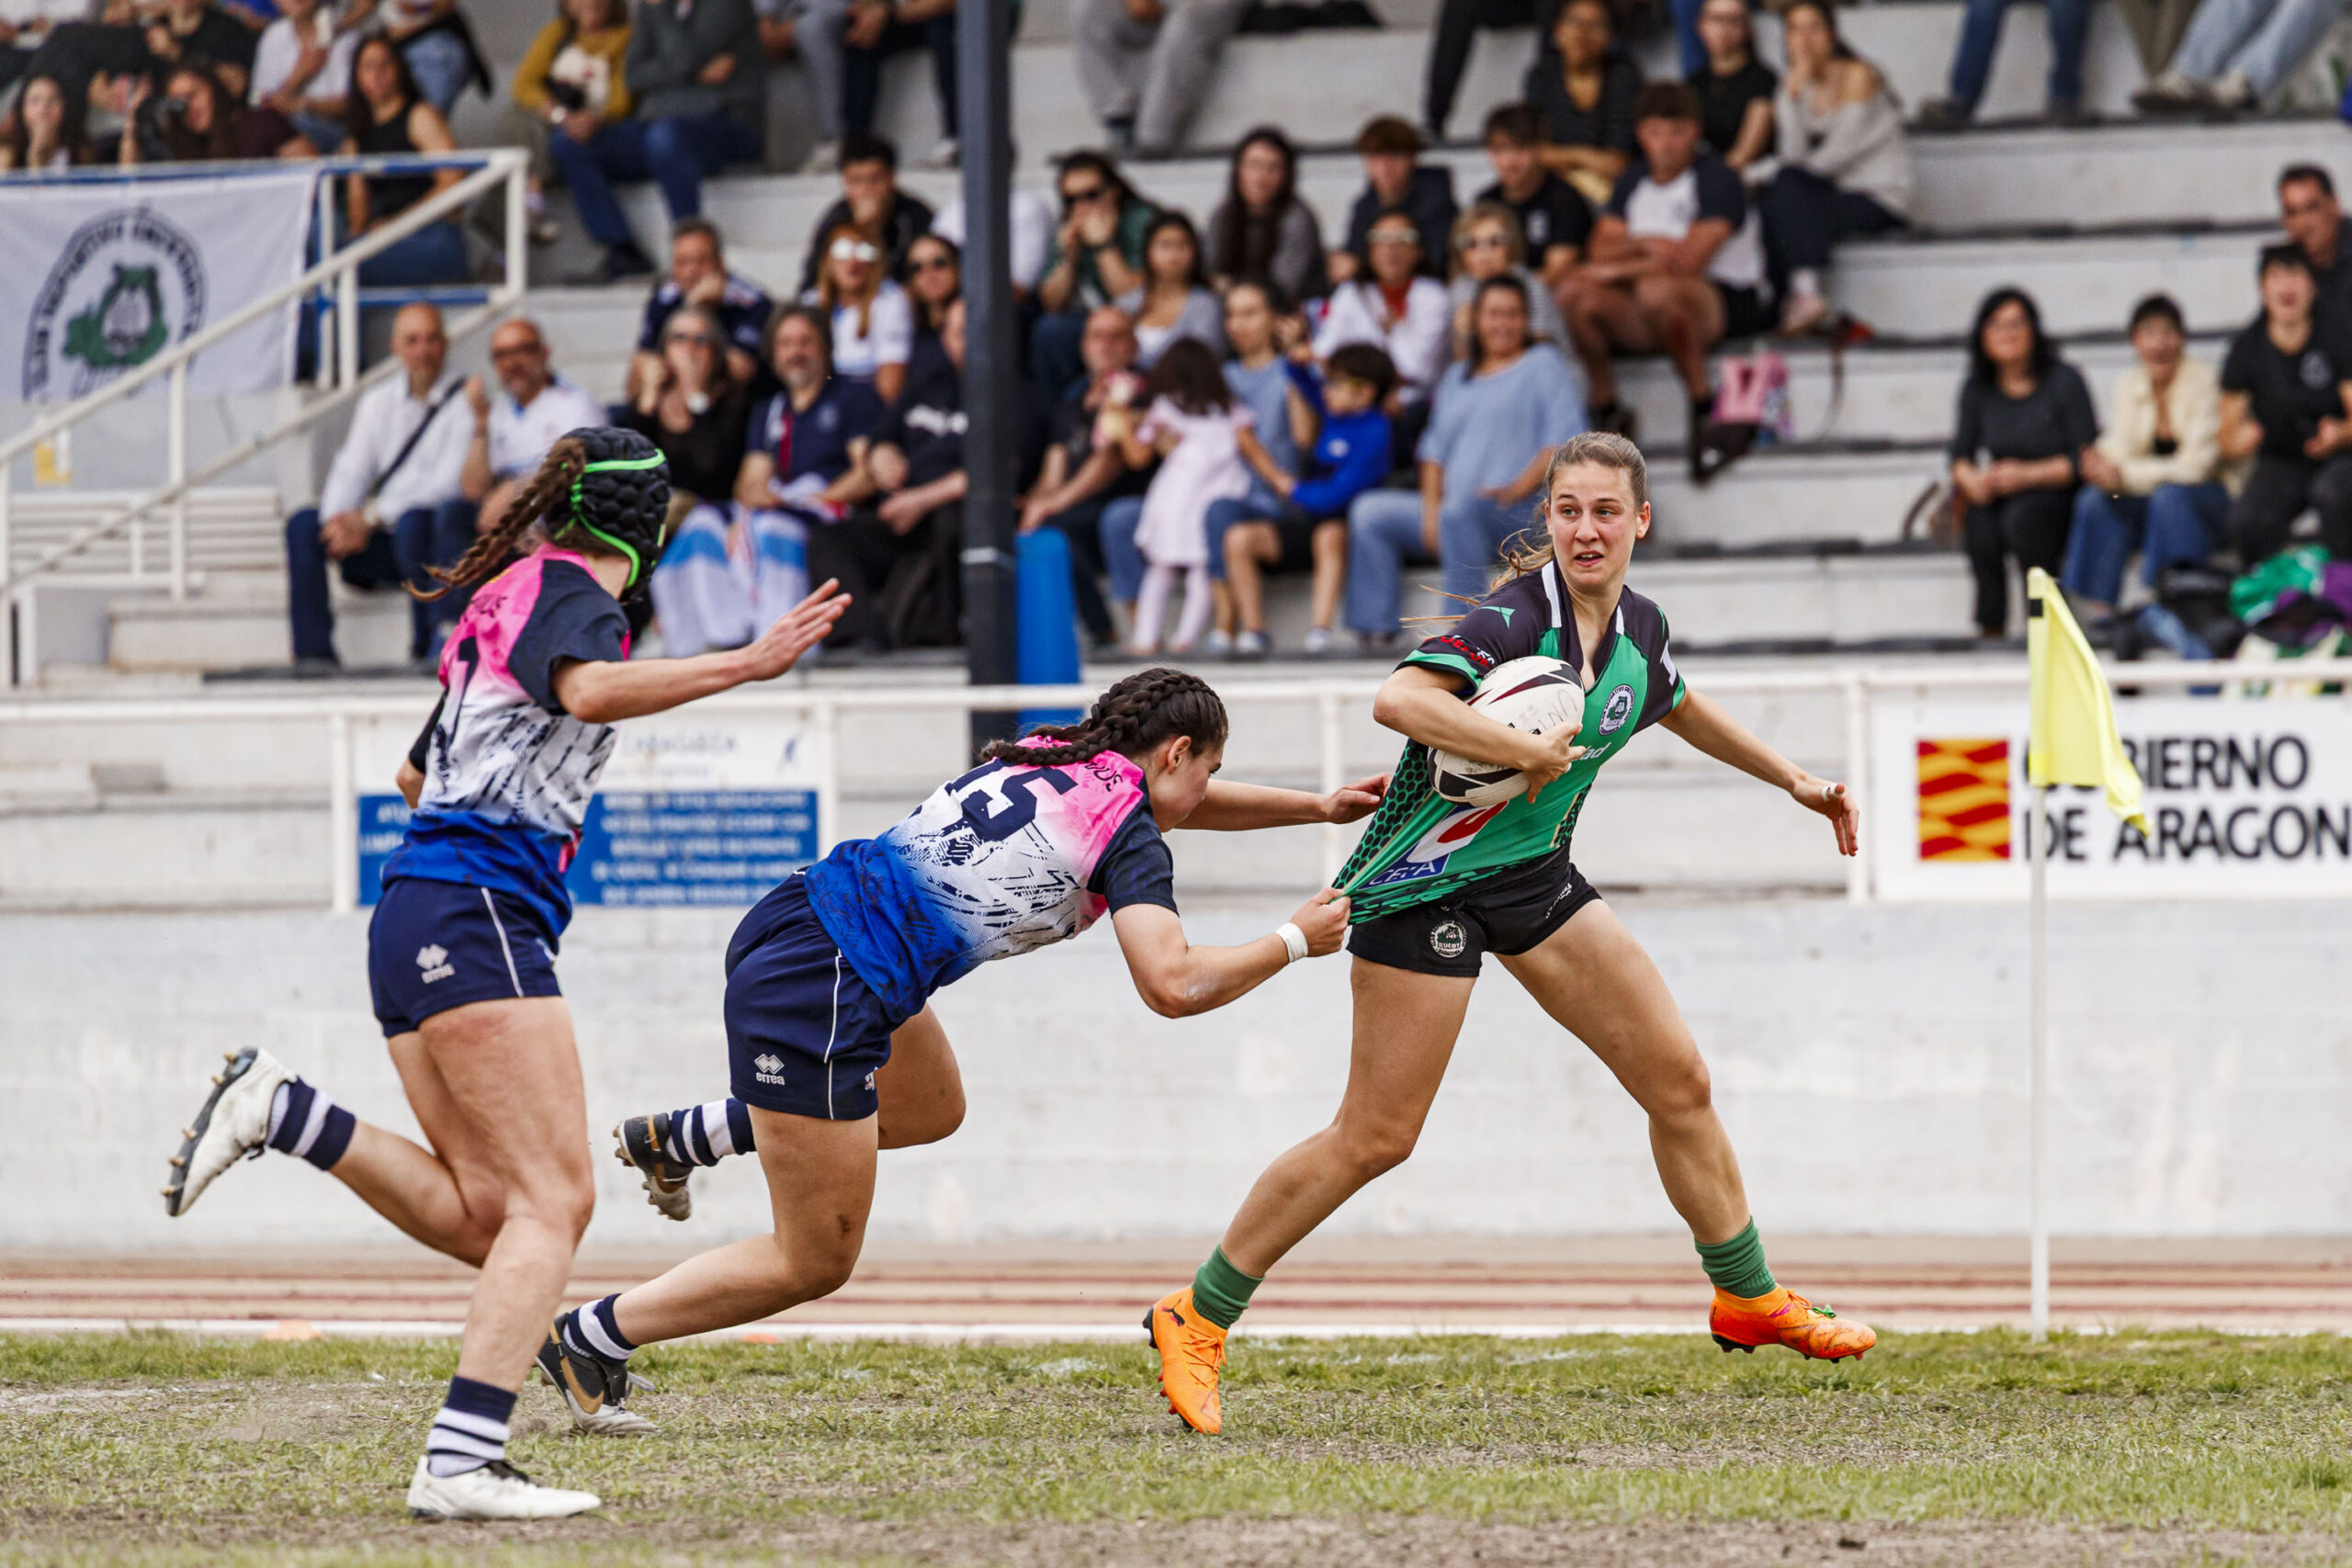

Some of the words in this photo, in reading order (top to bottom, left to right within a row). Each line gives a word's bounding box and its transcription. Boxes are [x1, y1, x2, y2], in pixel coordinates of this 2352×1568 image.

[2025, 735, 2310, 791] IERNO
[944, 756, 1079, 842] 15
[2114, 805, 2351, 861] ARAGON
